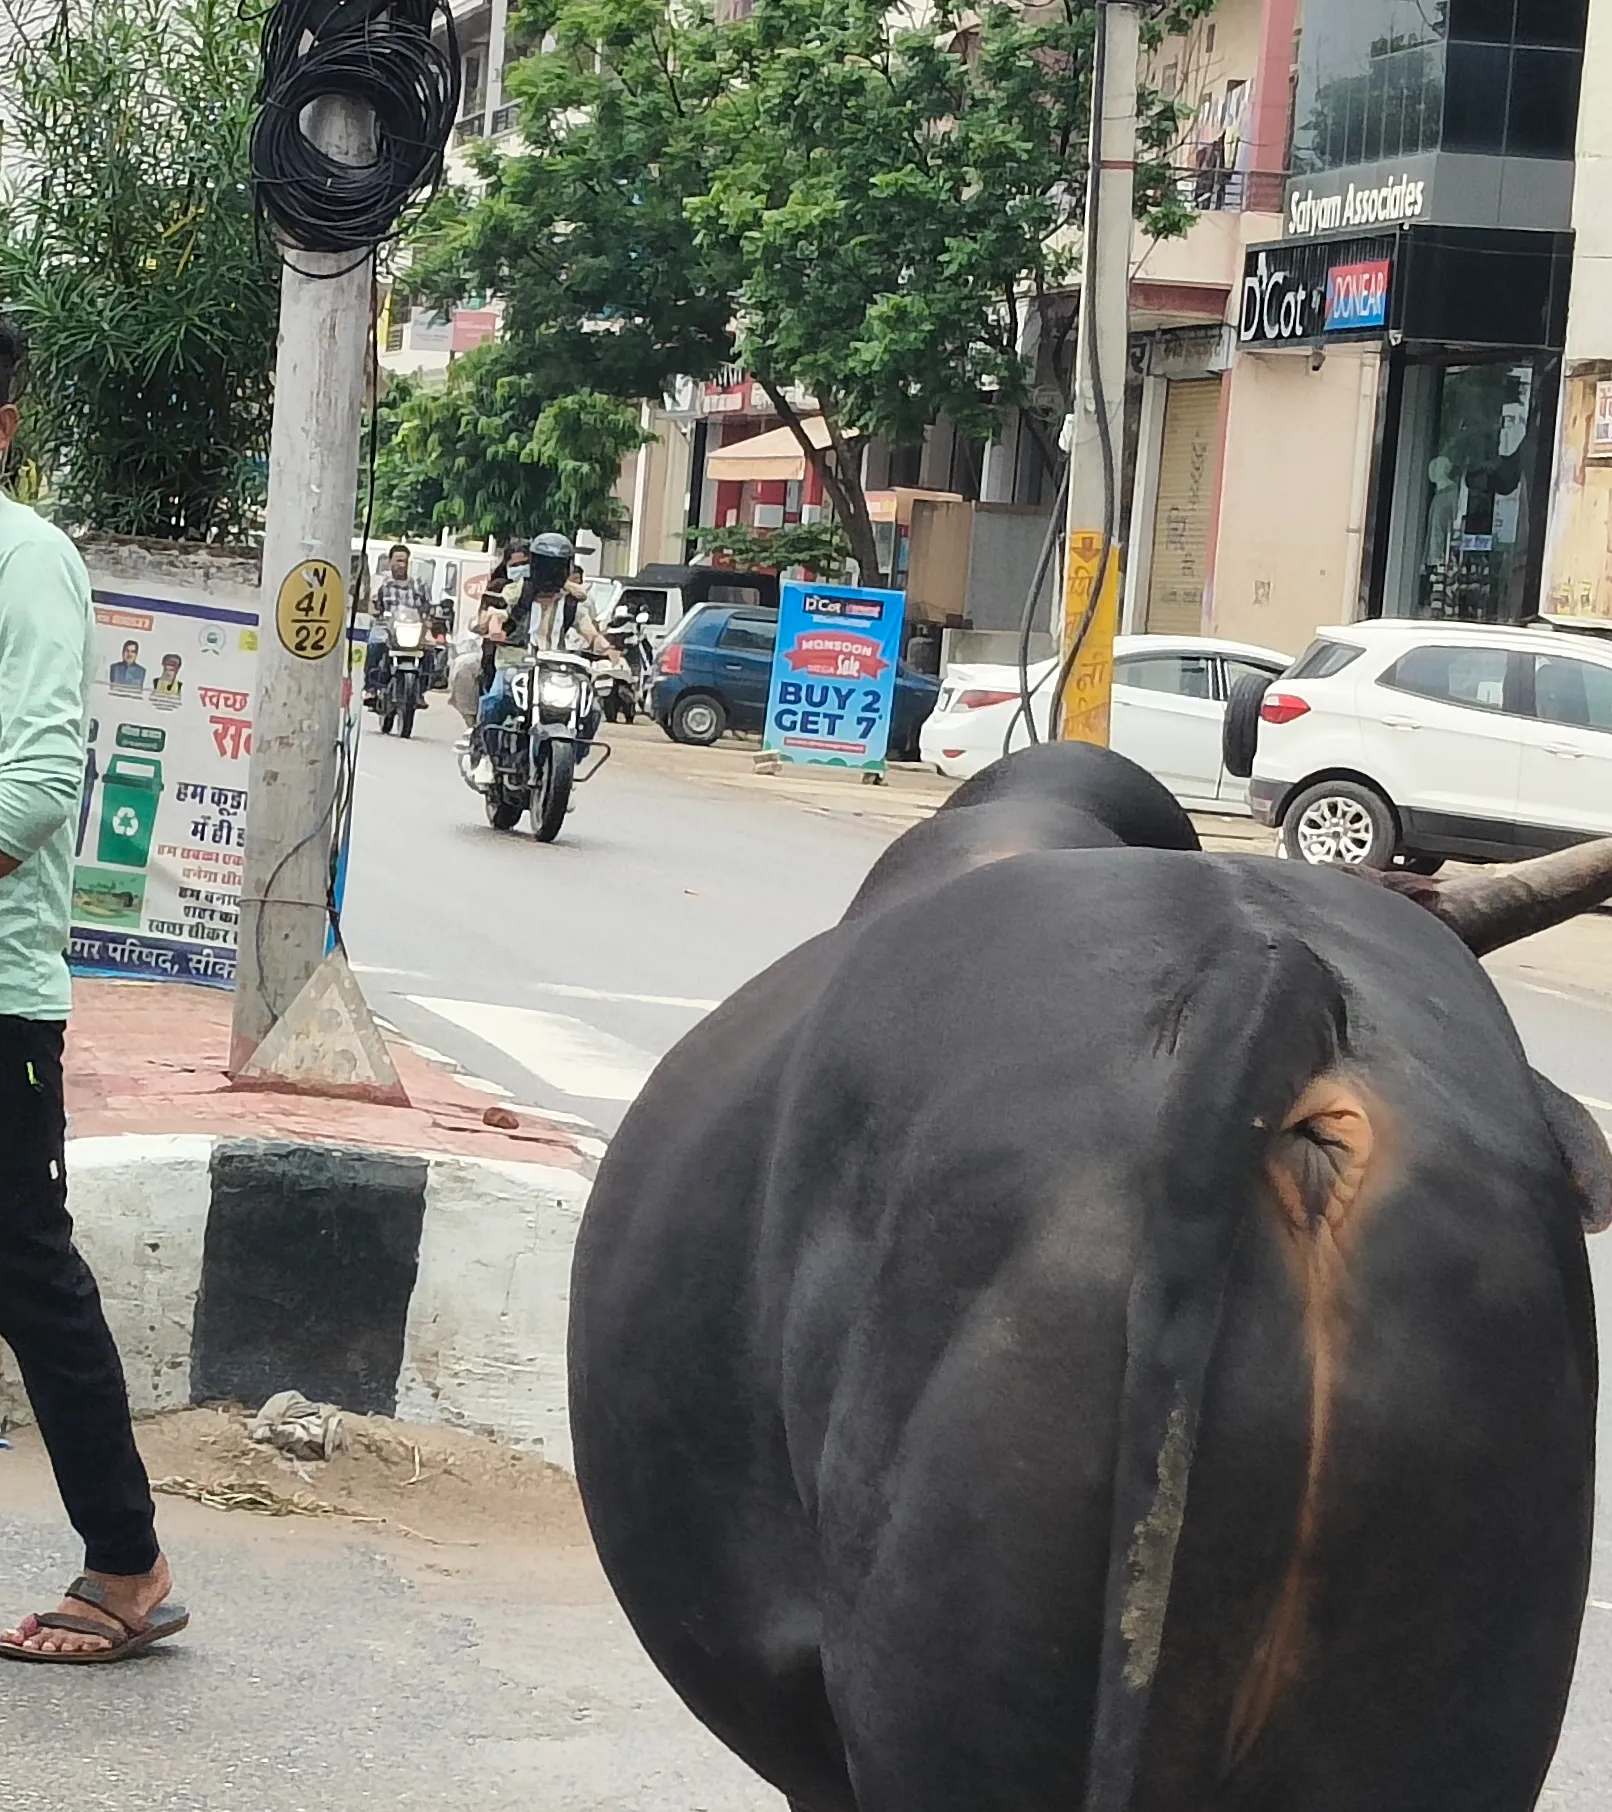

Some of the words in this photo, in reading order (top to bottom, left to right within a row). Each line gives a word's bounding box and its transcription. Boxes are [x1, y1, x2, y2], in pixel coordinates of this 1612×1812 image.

[1289, 190, 1342, 237] Satyam
[1342, 173, 1425, 227] Associates
[1332, 271, 1385, 319] DONEAR
[295, 591, 328, 617] 41
[294, 624, 327, 651] 22
[802, 639, 873, 656] MONSOON
[837, 654, 861, 678] Sale
[197, 686, 250, 713] स्वच्छ
[778, 681, 856, 711] BUY
[860, 689, 881, 713] 2
[774, 708, 844, 737] GET
[176, 781, 208, 805] हम
[190, 814, 212, 841] में
[211, 818, 233, 846] ही
[72, 937, 102, 961] गर
[188, 948, 237, 980] सीक
